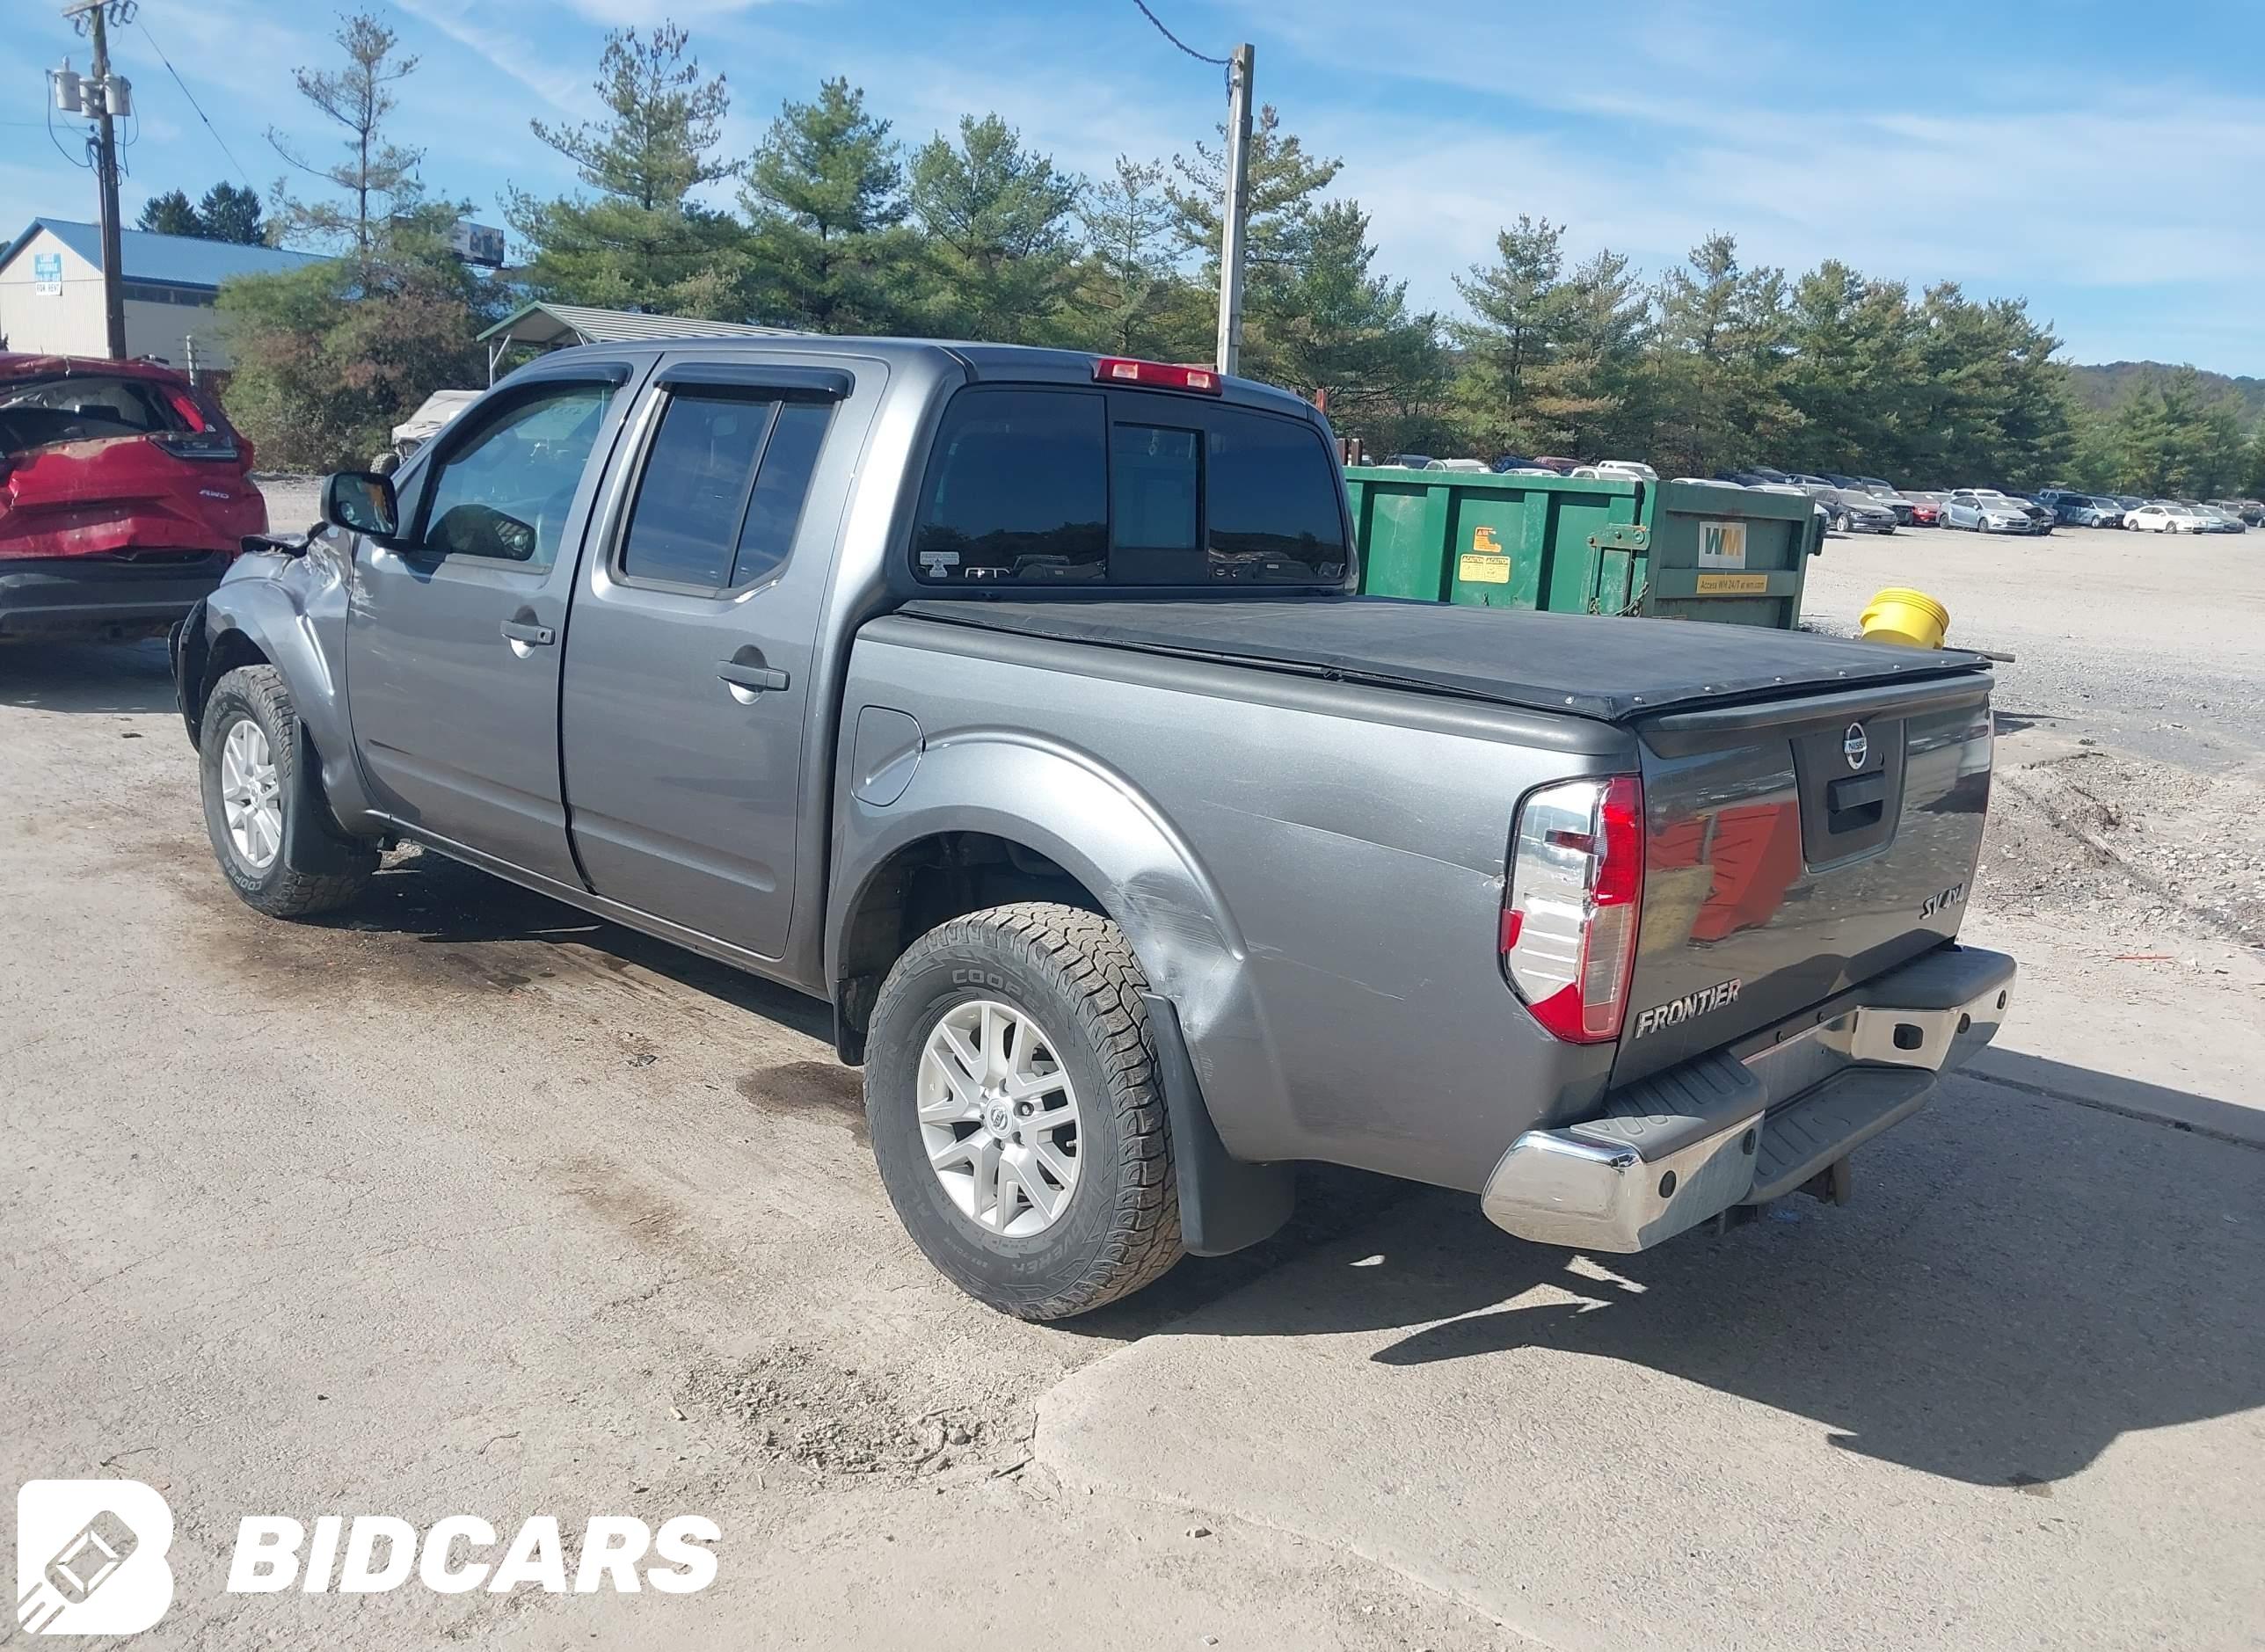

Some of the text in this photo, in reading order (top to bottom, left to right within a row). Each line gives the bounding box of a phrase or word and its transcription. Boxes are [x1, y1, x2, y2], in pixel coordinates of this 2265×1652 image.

[200, 489, 229, 499] AWD
[1705, 527, 1742, 556] WM
[1701, 579, 1717, 590] Access
[1728, 579, 1740, 590] 24/7
[1919, 893, 1942, 921] SV
[1633, 978, 1742, 1039] FRONTIER
